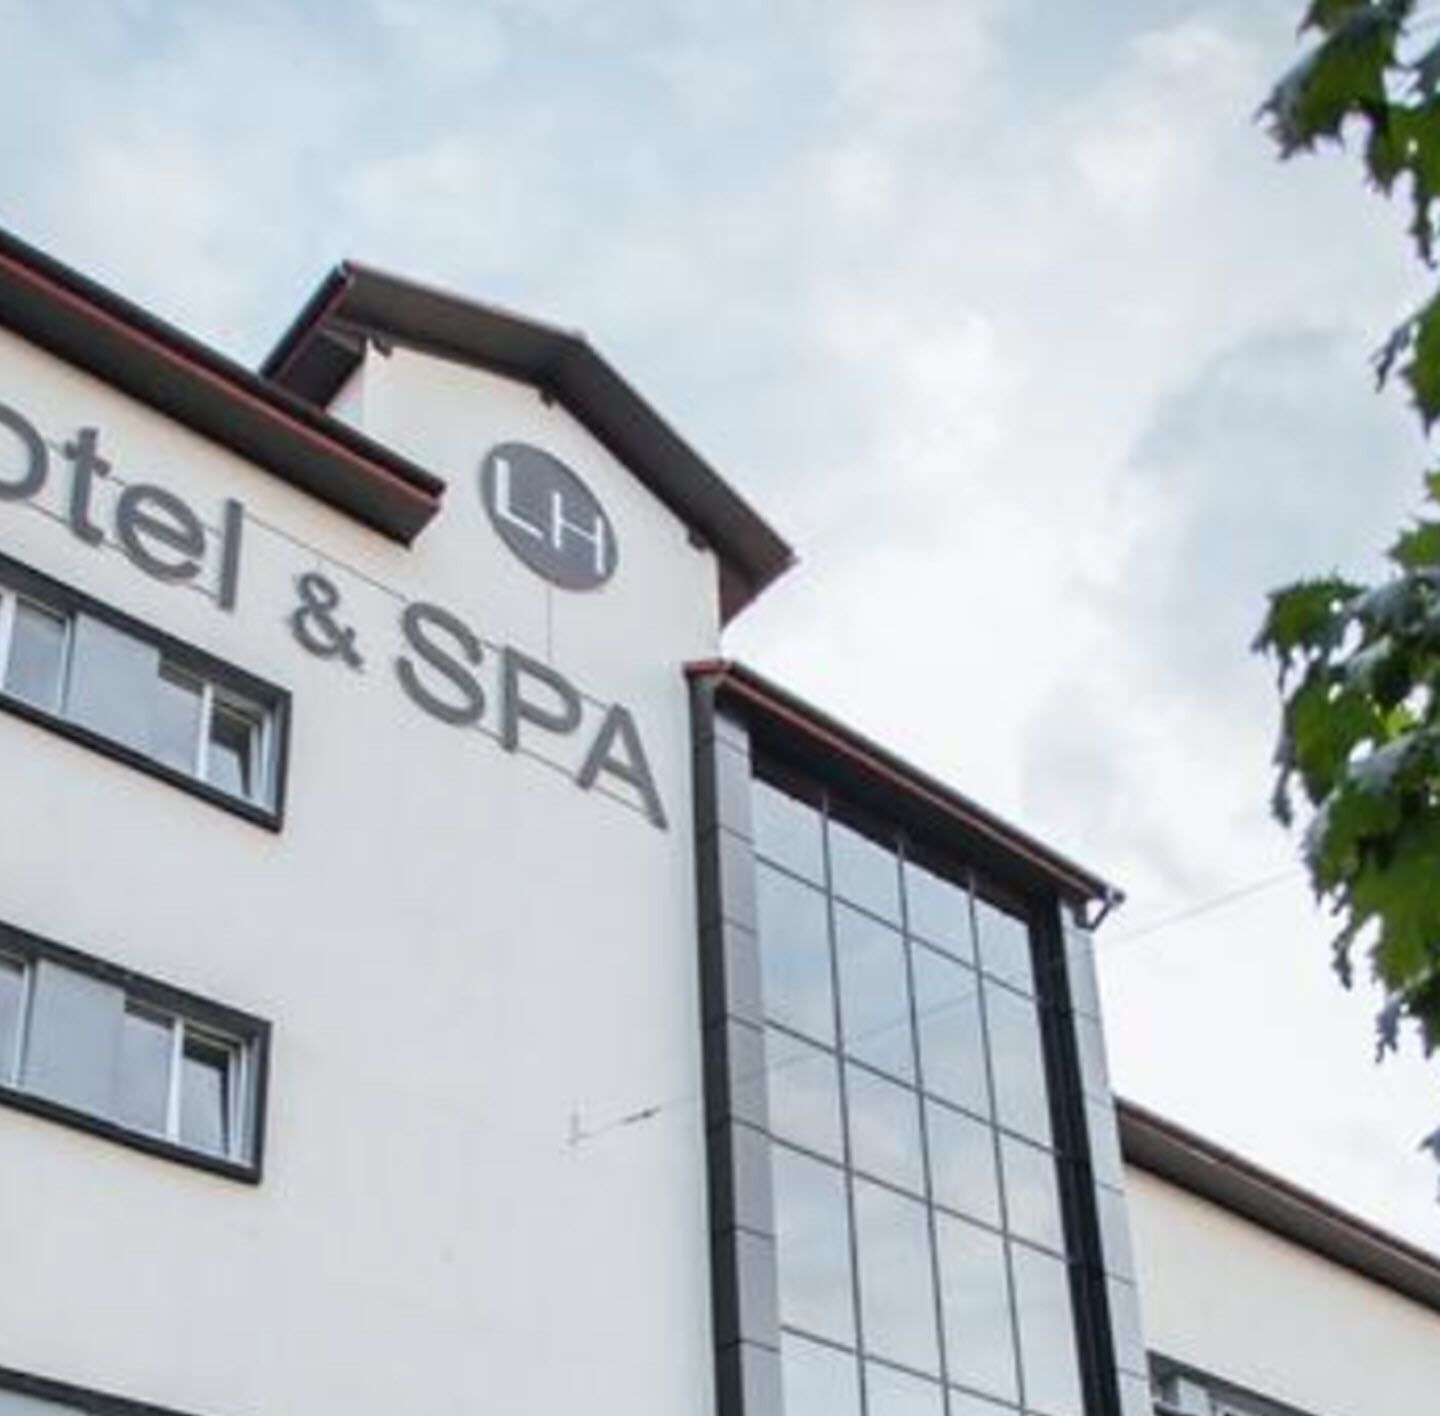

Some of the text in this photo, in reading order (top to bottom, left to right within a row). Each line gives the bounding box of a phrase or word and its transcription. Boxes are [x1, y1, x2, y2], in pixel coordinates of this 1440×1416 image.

[493, 458, 607, 577] LH
[291, 571, 362, 671] &
[396, 601, 668, 829] SPA
